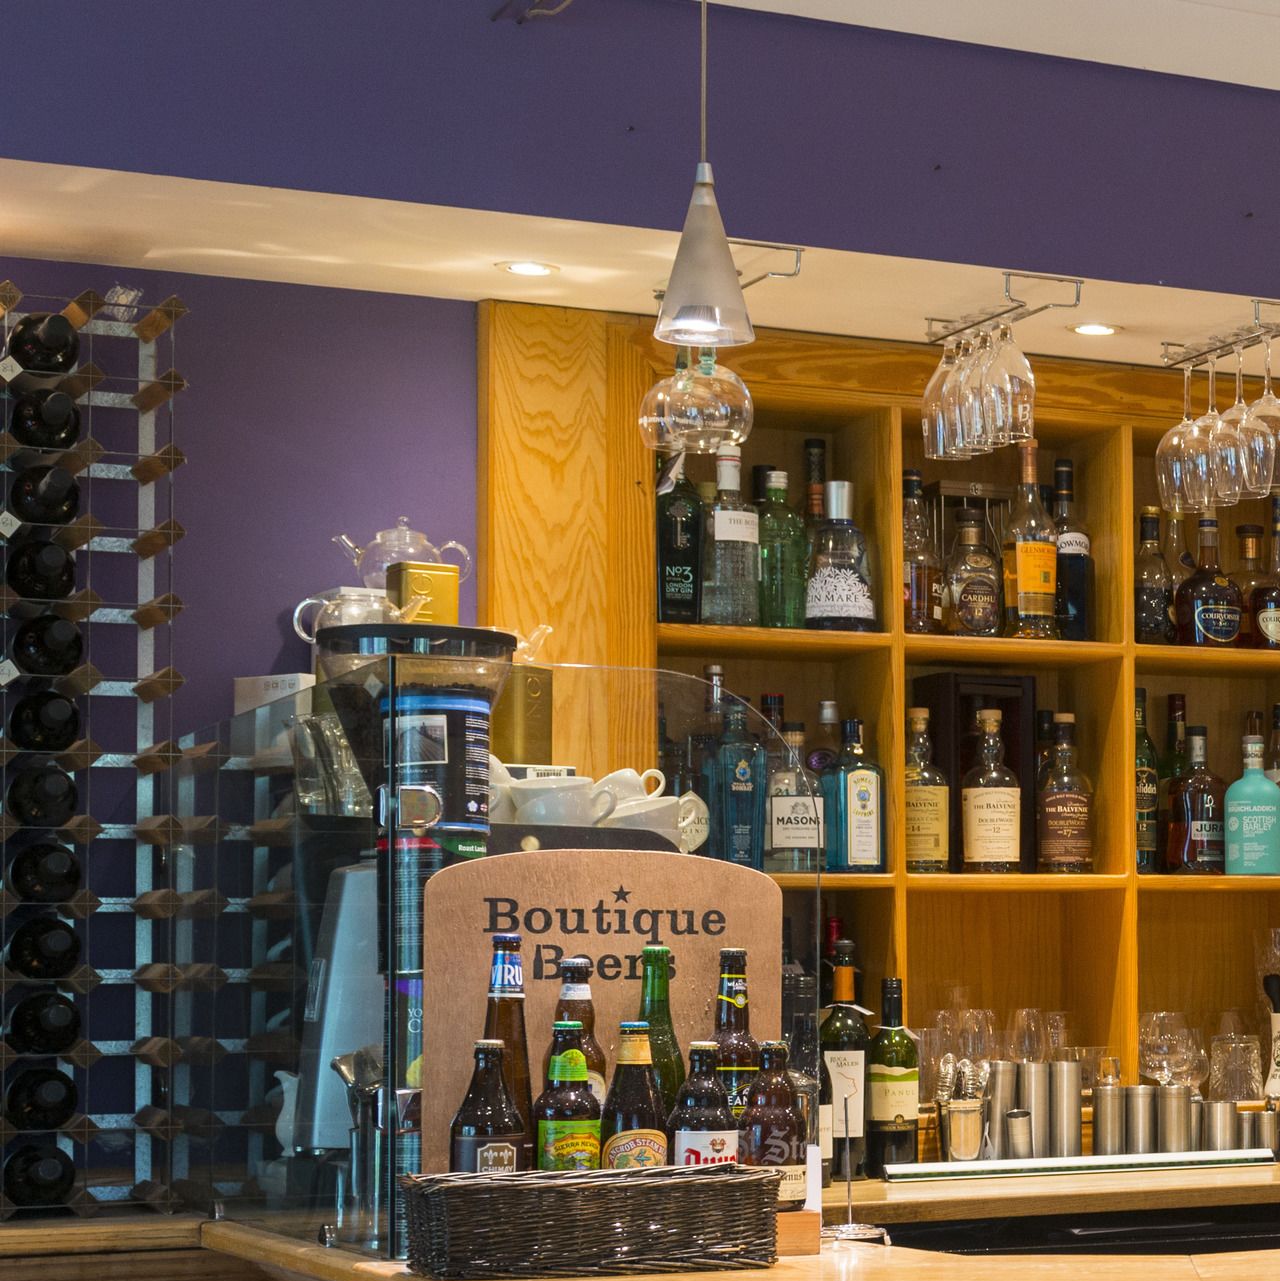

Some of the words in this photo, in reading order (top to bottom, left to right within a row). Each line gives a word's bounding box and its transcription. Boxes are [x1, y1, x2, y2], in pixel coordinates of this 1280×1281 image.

[824, 594, 859, 603] MARE
[776, 816, 822, 826] MASONS
[1242, 816, 1276, 824] SCOTTISH
[1196, 824, 1224, 832] JURA
[458, 844, 473, 852] Roast
[483, 896, 726, 947] Boutique
[492, 964, 523, 986] VIRU
[884, 1088, 915, 1097] PANUL
[554, 1141, 580, 1153] SIERRA
[608, 1140, 636, 1163] ANCHOR
[636, 1138, 659, 1150] STEAM
